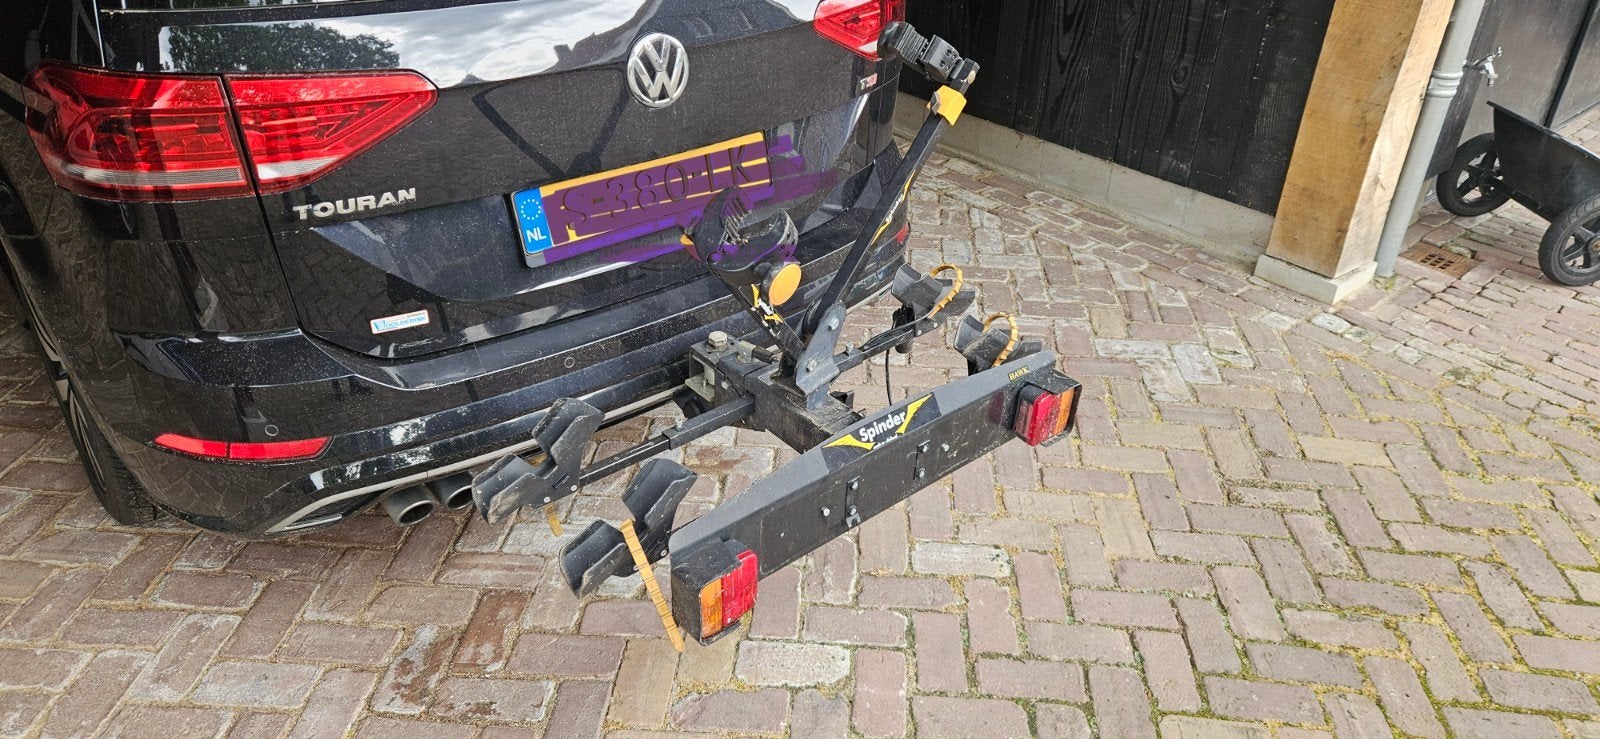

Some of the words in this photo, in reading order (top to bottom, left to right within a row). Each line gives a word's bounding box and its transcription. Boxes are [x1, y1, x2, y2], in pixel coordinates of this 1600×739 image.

[293, 187, 417, 220] TOURAN
[526, 226, 547, 243] NL
[859, 411, 906, 443] Spinder
